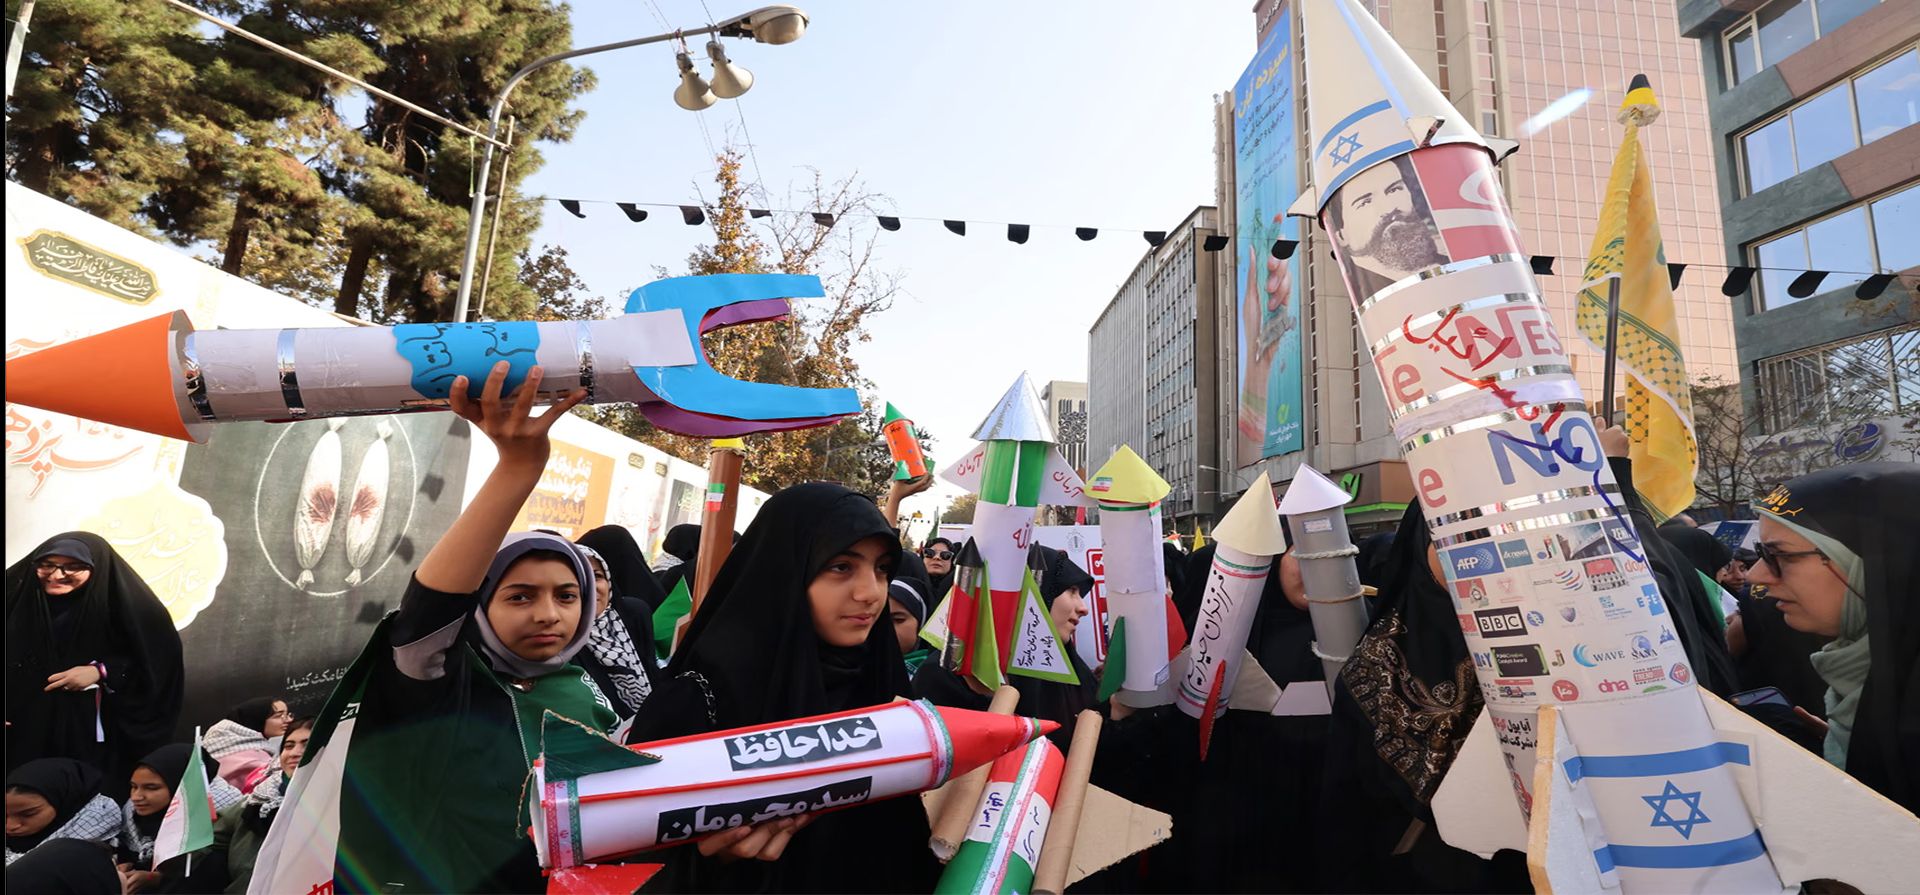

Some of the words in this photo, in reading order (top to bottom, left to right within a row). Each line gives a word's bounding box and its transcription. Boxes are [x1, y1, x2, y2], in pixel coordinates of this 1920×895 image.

[957, 451, 984, 476] آرمان
[1053, 471, 1084, 498] آرمان
[1457, 557, 1479, 571] AFP
[1203, 569, 1234, 640] فرزندان
[1481, 615, 1520, 631] BBC
[1593, 650, 1625, 662] WAVE
[1598, 679, 1630, 693] dna
[732, 719, 878, 765] خداحافظ
[662, 798, 808, 842] محرومان
